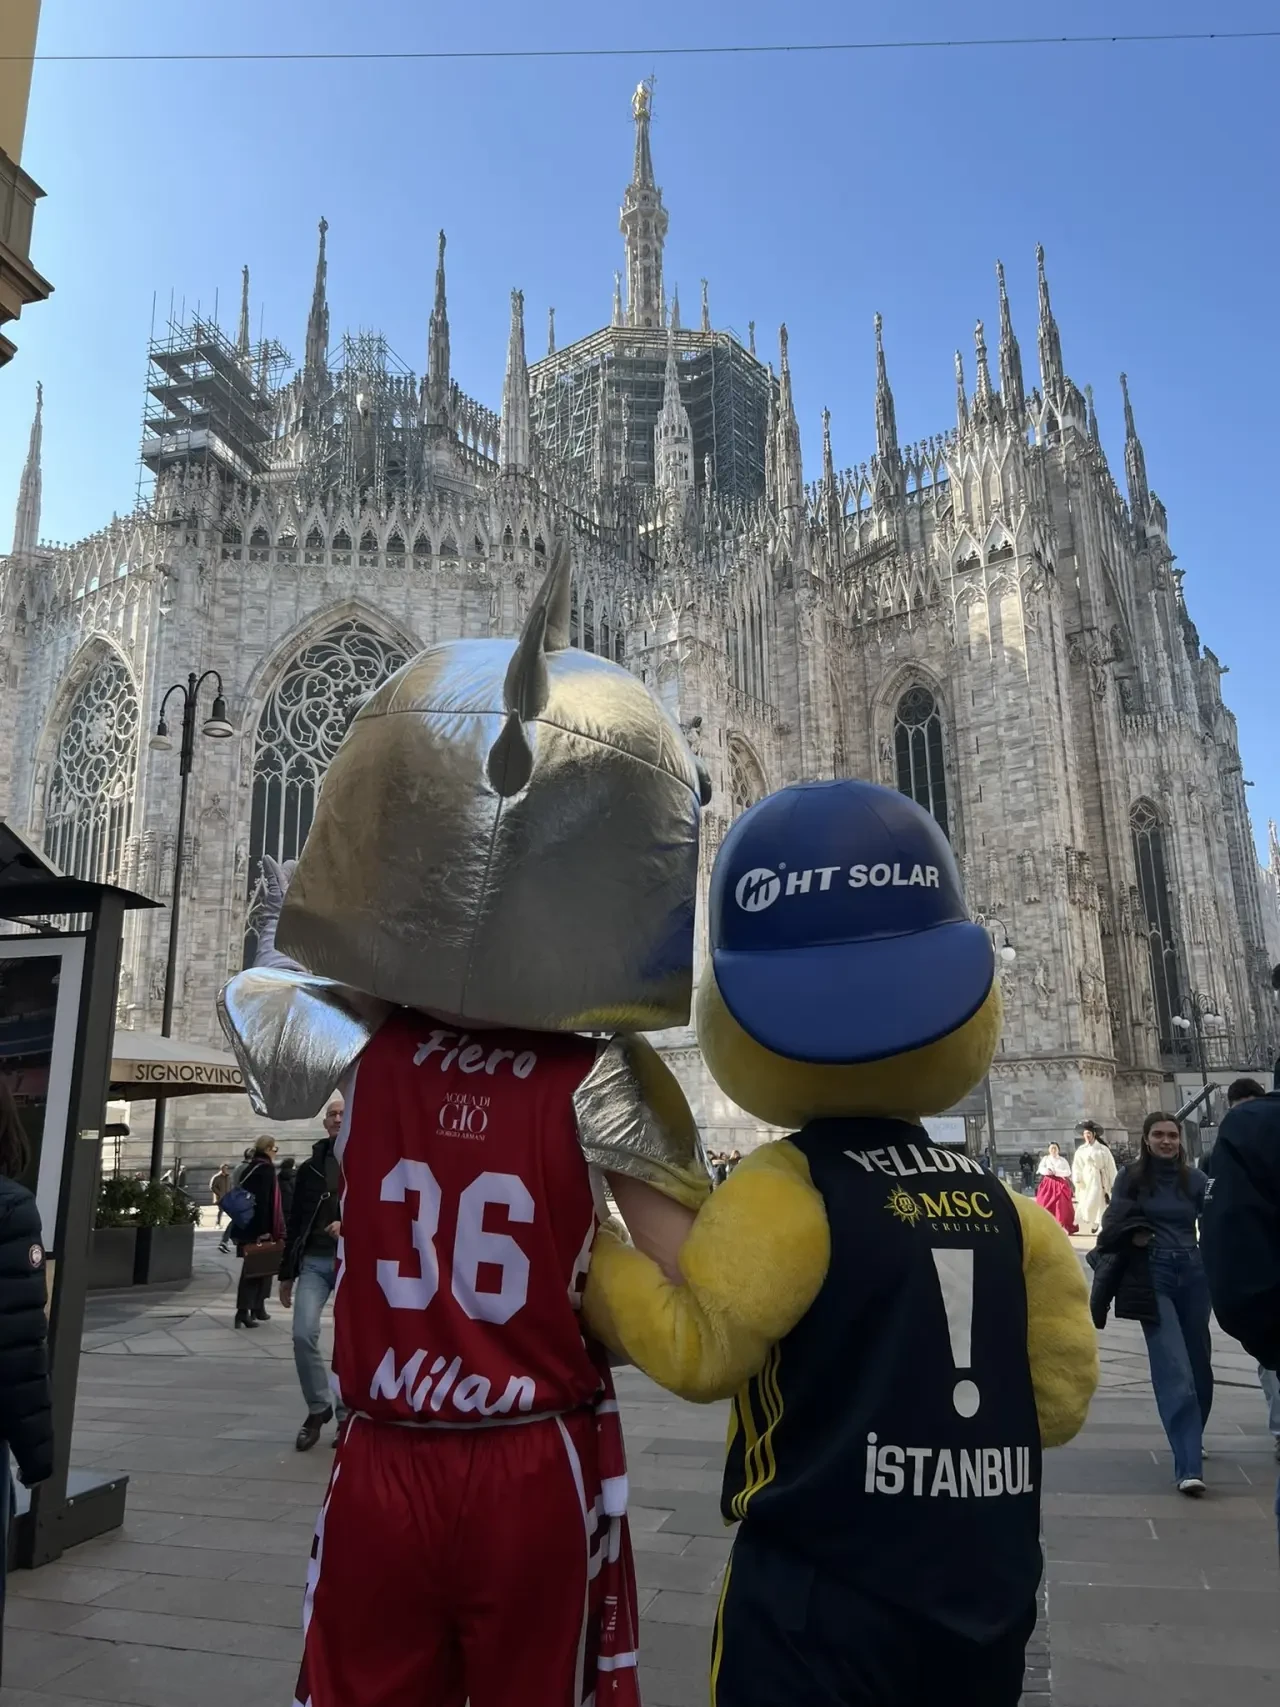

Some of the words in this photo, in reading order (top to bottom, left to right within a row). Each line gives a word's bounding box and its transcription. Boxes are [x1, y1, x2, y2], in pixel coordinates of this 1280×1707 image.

[785, 866, 841, 896] HT
[848, 863, 940, 889] SOLAR
[412, 1029, 538, 1079] Fiero
[135, 1063, 243, 1084] SIGNORVINO
[843, 1143, 985, 1177] YELLOW
[918, 1191, 993, 1219] MSC
[376, 1157, 536, 1325] 36
[931, 1223, 1000, 1234] CRUISES
[370, 1346, 536, 1416] Milan
